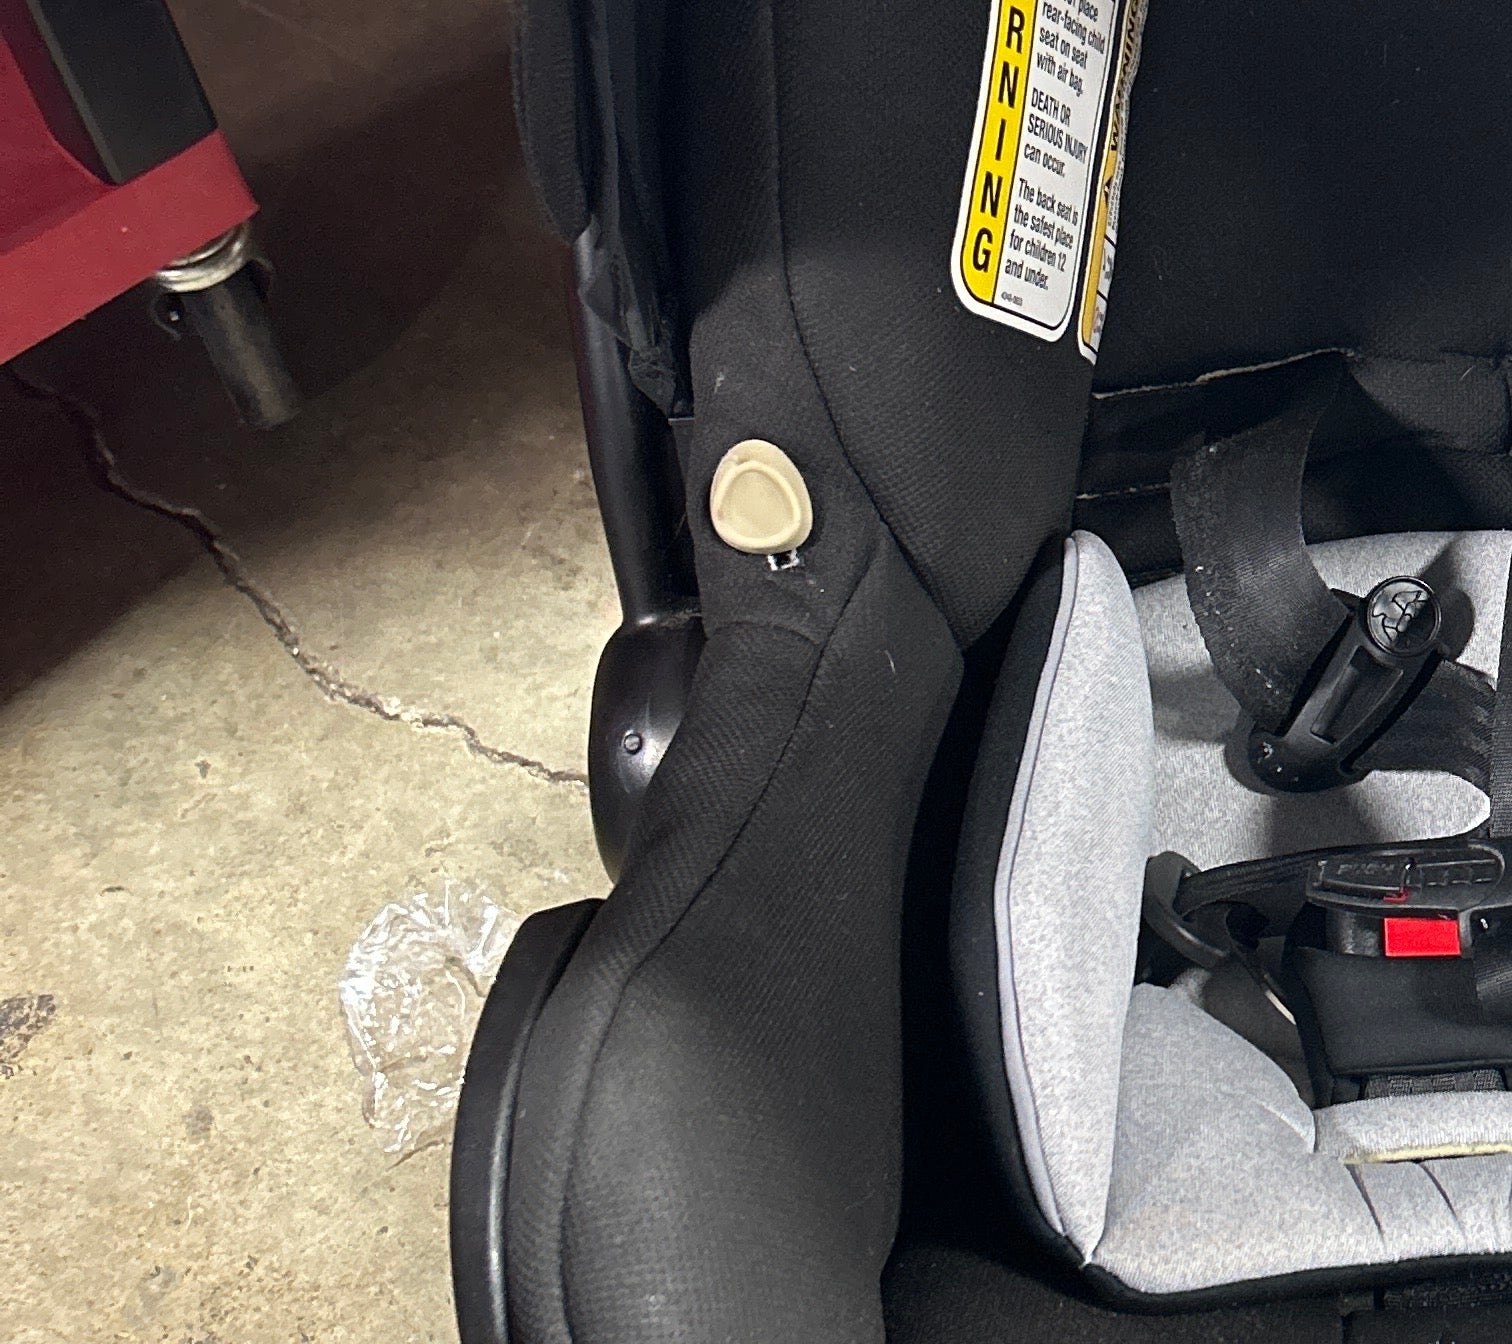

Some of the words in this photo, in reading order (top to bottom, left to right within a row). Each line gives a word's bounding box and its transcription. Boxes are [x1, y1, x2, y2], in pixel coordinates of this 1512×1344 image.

[1040, 27, 1059, 52] seat
[1060, 38, 1070, 58] on
[1071, 45, 1088, 70] seat
[1042, 1, 1087, 46] rear-facing
[1088, 29, 1105, 55] child
[1036, 51, 1056, 76] with
[1057, 62, 1068, 83] air
[1031, 87, 1060, 120] DEATH
[1060, 104, 1071, 127] OR
[1027, 113, 1064, 149] SERIOUS
[1064, 133, 1088, 164] INJURY
[1024, 143, 1041, 164] can
[1042, 152, 1066, 178] occur.
[1019, 177, 1035, 203] The
[1036, 187, 1056, 214] back
[1056, 201, 1073, 223] seat
[1072, 205, 1079, 226] is
[1014, 203, 1029, 228] the
[1030, 214, 1056, 240] safest
[1054, 225, 1074, 250] place
[1004, 258, 1025, 279] and
[1009, 229, 1025, 253] for
[1024, 237, 1057, 267] children
[1057, 251, 1067, 273] 12
